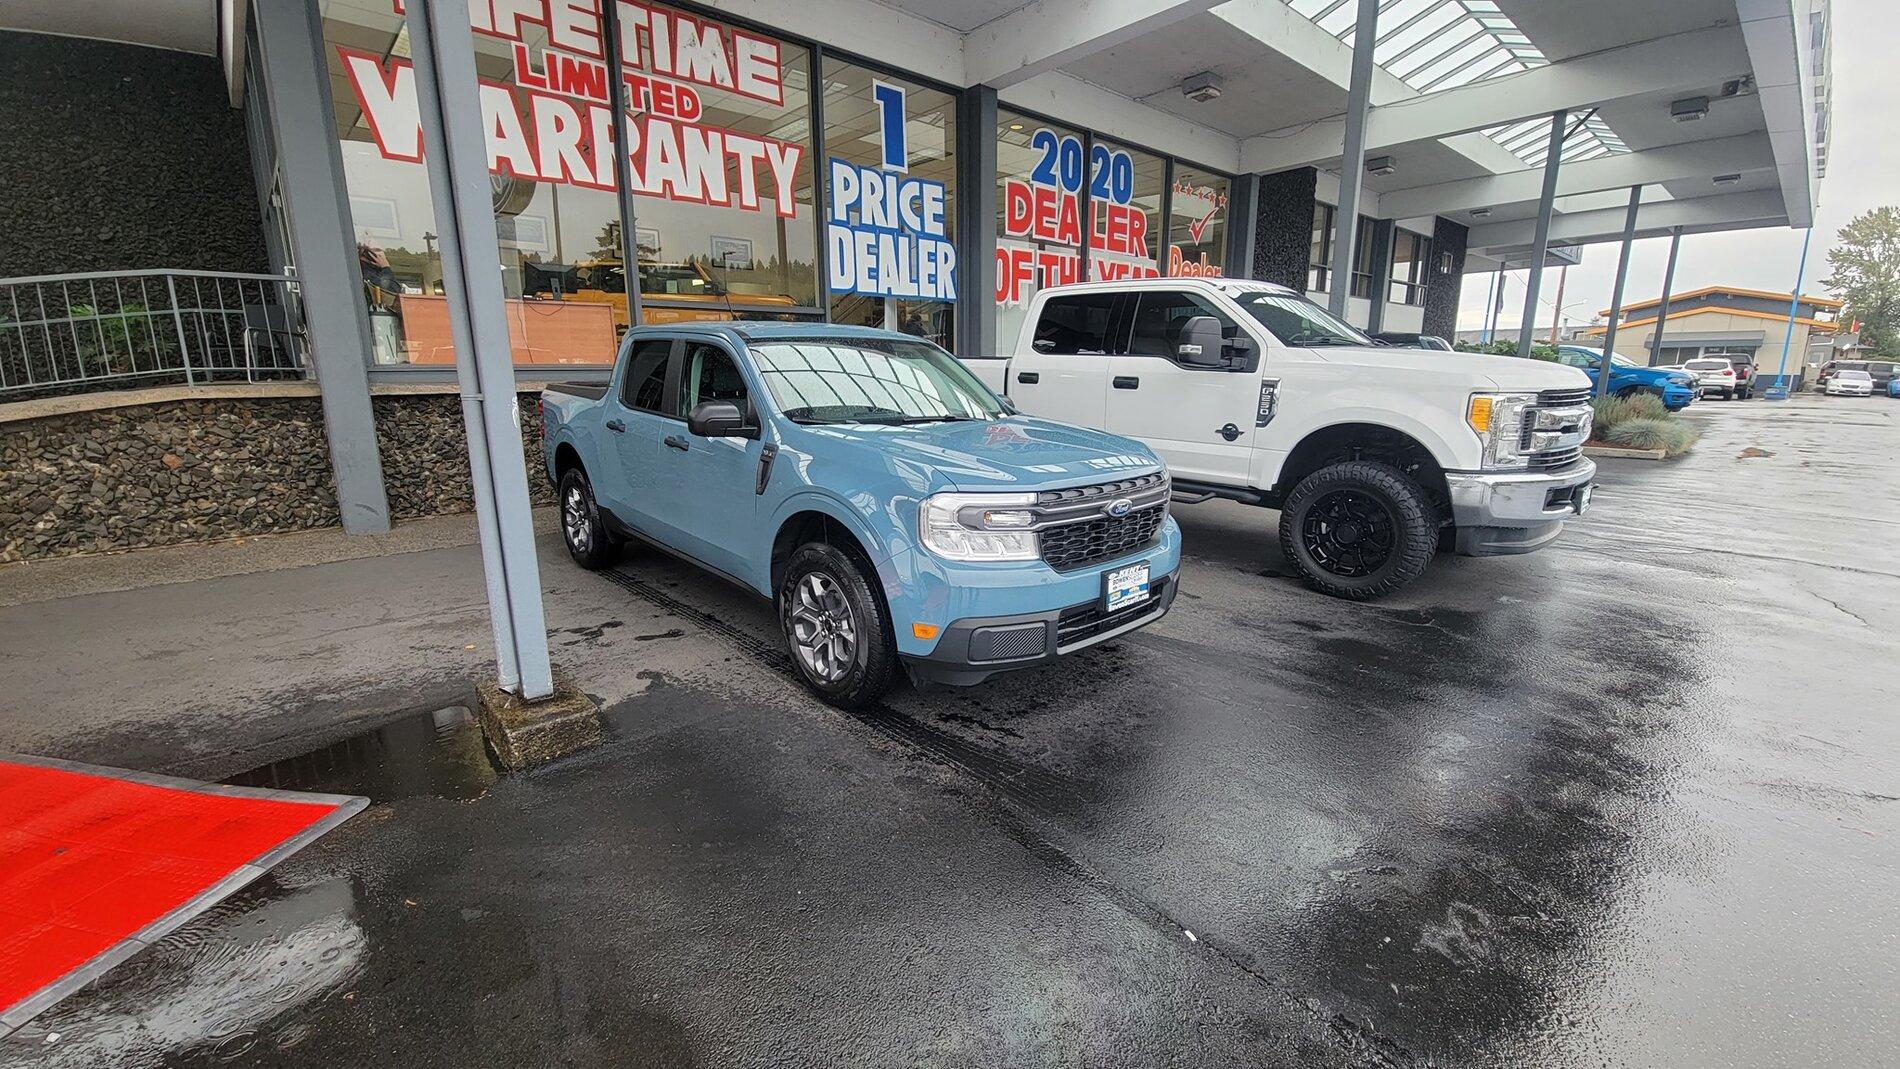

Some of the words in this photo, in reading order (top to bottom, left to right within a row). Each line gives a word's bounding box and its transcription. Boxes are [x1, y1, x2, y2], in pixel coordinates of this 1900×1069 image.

[392, 0, 783, 106] ETIME
[511, 42, 702, 122] LIMTED
[873, 78, 907, 174] 1
[830, 158, 945, 239] PRICE
[1030, 128, 1134, 205] 2020
[1006, 178, 1148, 258] DEALER
[827, 223, 957, 301] DEALER
[995, 249, 1033, 304] OF
[1037, 252, 1091, 289] TH
